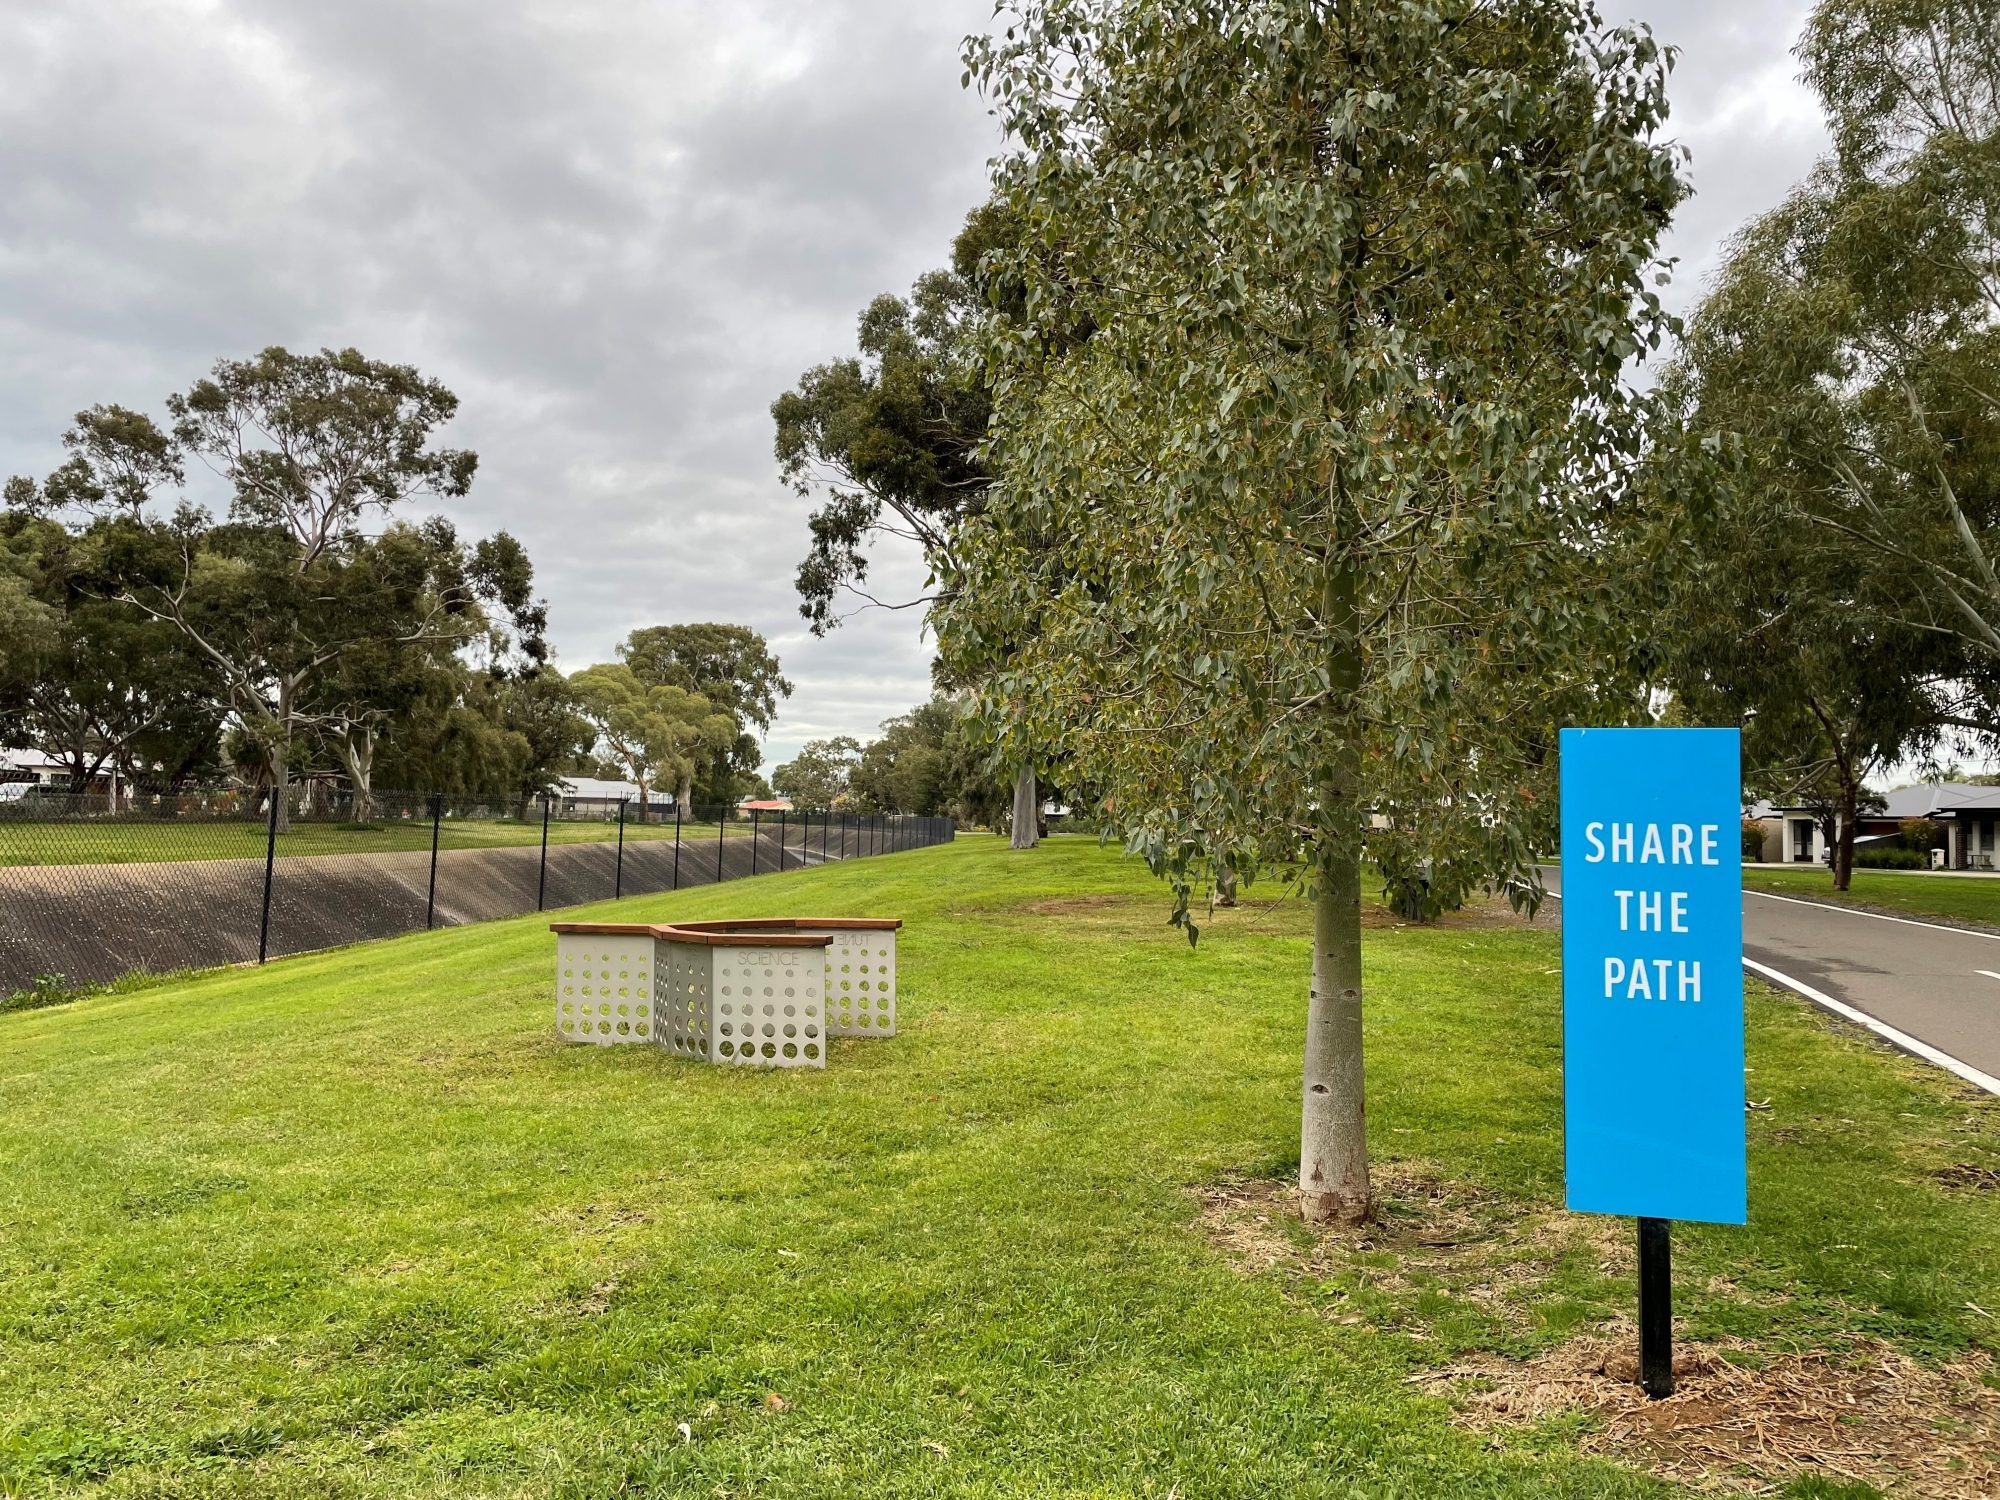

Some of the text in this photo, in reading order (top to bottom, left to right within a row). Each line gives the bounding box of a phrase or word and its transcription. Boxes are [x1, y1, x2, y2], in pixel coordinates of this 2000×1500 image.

[1585, 821, 1719, 865] SHARE
[1613, 890, 1689, 933] THE
[737, 951, 801, 966] SCIENCE
[1604, 957, 1700, 1002] PATH
